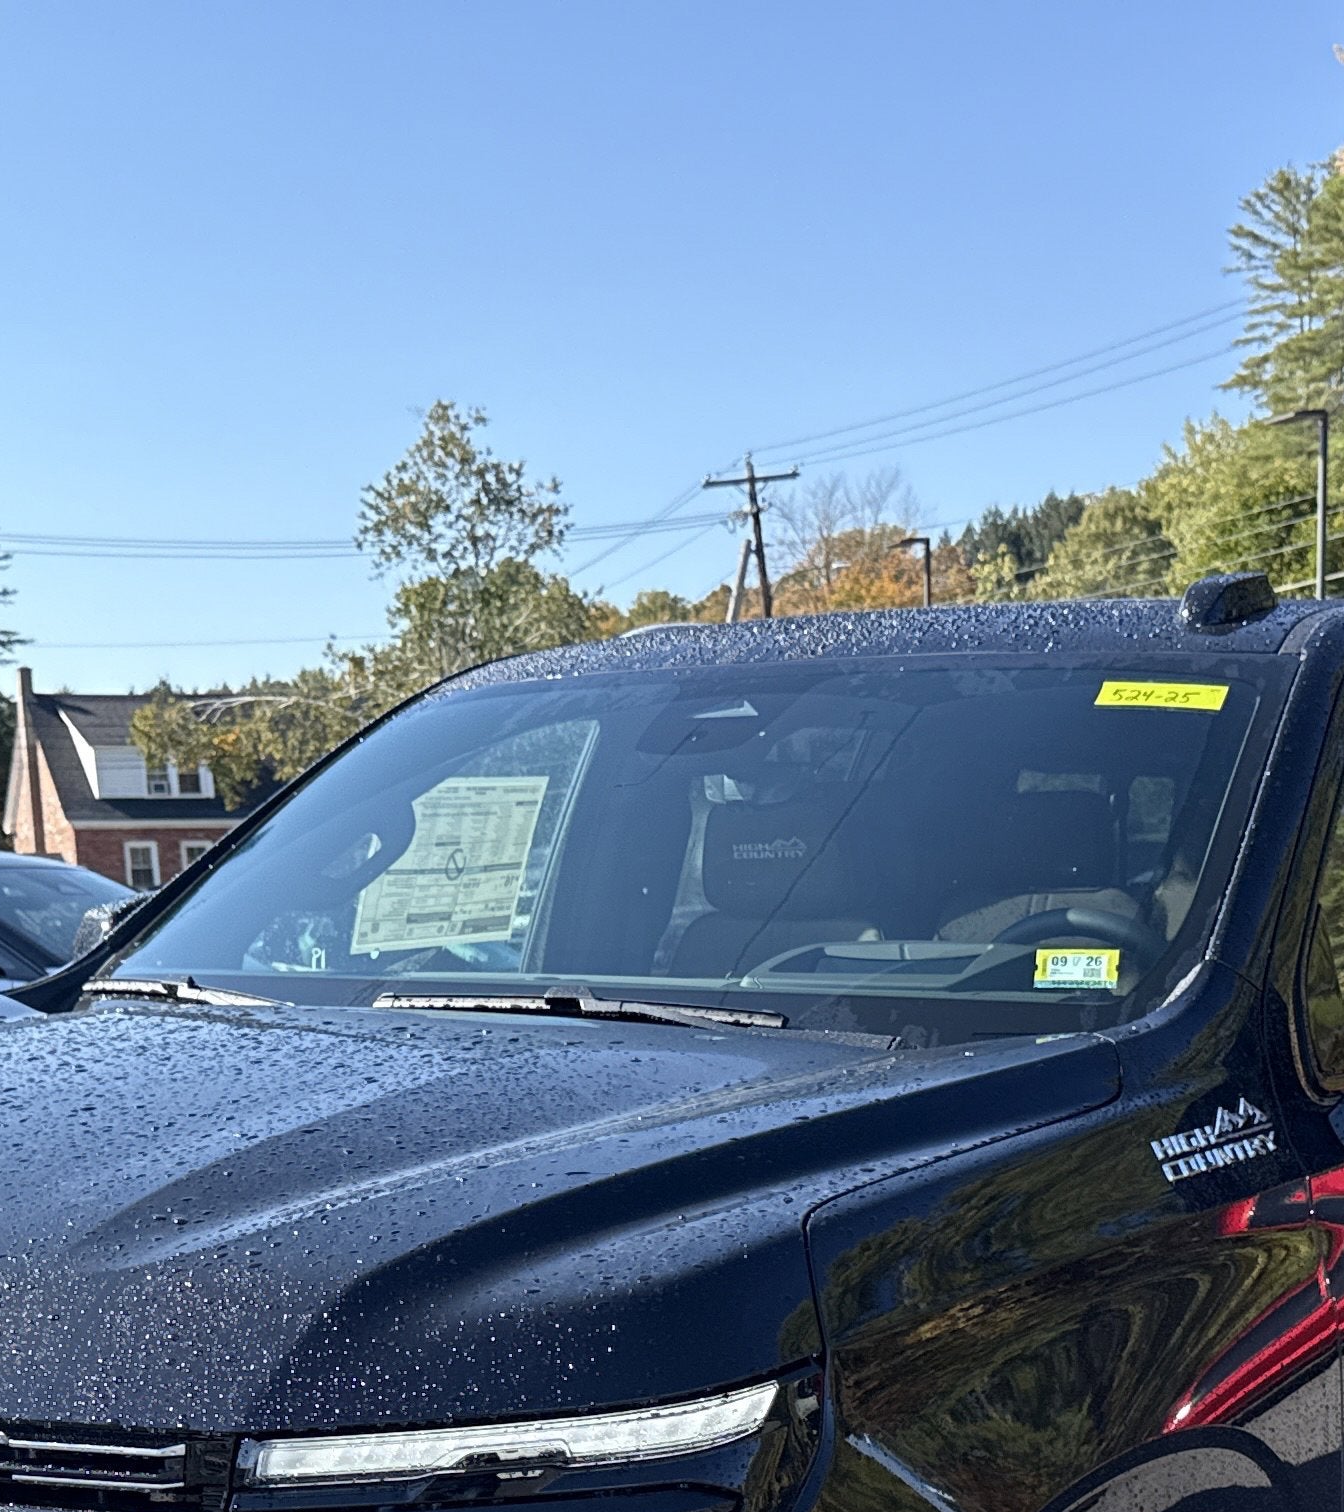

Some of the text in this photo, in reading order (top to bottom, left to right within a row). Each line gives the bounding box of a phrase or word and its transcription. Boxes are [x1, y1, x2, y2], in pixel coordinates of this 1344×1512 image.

[1112, 688, 1201, 704] 524-25
[1051, 956, 1103, 967] 09 26
[1150, 1125, 1217, 1161] HIGH
[1161, 1130, 1277, 1182] COUNTRY
